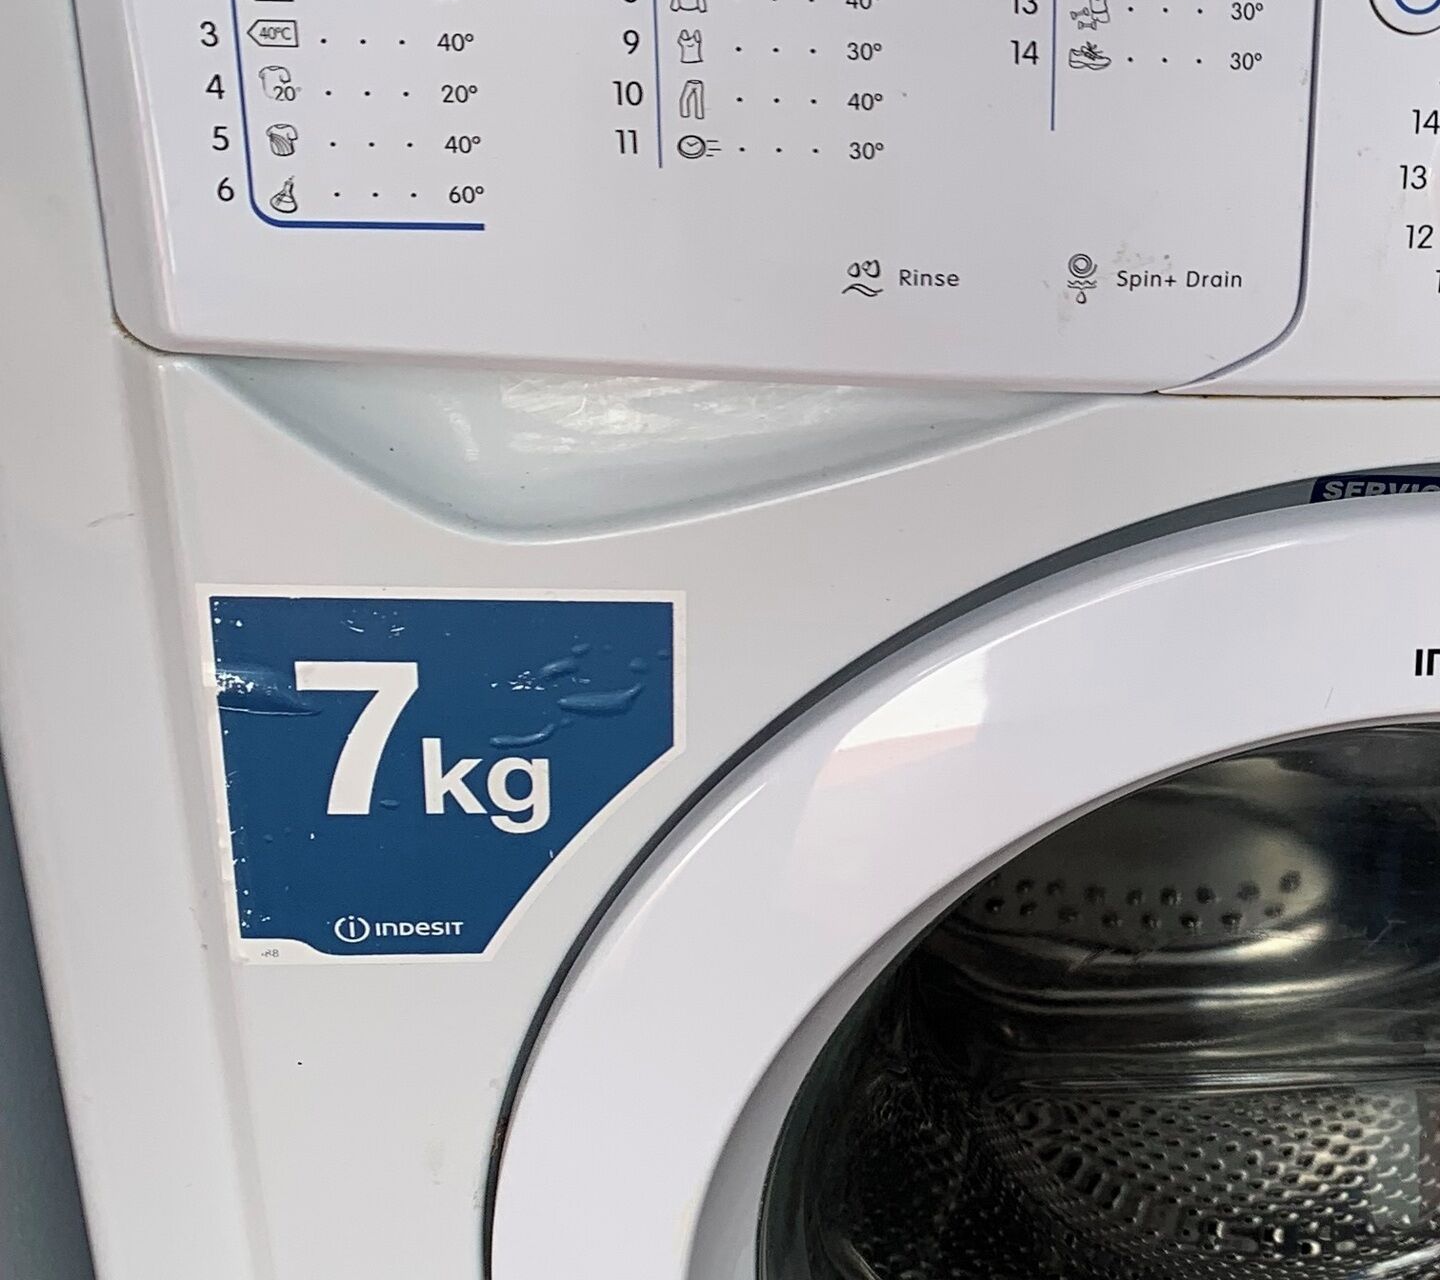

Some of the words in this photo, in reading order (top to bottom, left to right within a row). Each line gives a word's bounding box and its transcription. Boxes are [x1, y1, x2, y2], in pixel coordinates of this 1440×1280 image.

[1231, 2, 1263, 21] 30°
[200, 21, 218, 47] 3
[437, 33, 474, 52] 40°
[623, 30, 639, 55] 9
[847, 43, 882, 61] 30°
[1010, 40, 1039, 65] 14
[1230, 52, 1262, 70] 30°
[206, 74, 226, 100] 4
[441, 85, 478, 104] 20°
[613, 81, 643, 106] 10
[847, 93, 883, 111] 40°
[1412, 110, 1440, 135] 14
[212, 126, 229, 151] 5
[444, 136, 481, 154] 40°
[615, 129, 638, 154] 11
[849, 142, 884, 160] 30°
[217, 177, 234, 202] 6
[449, 186, 484, 205] 60°
[1400, 165, 1427, 189] 13
[1406, 225, 1433, 249] 12
[899, 270, 959, 287] Rinse
[1116, 270, 1177, 292] Spin+
[1186, 271, 1242, 288] Drain
[375, 920, 463, 936] INDESIT
